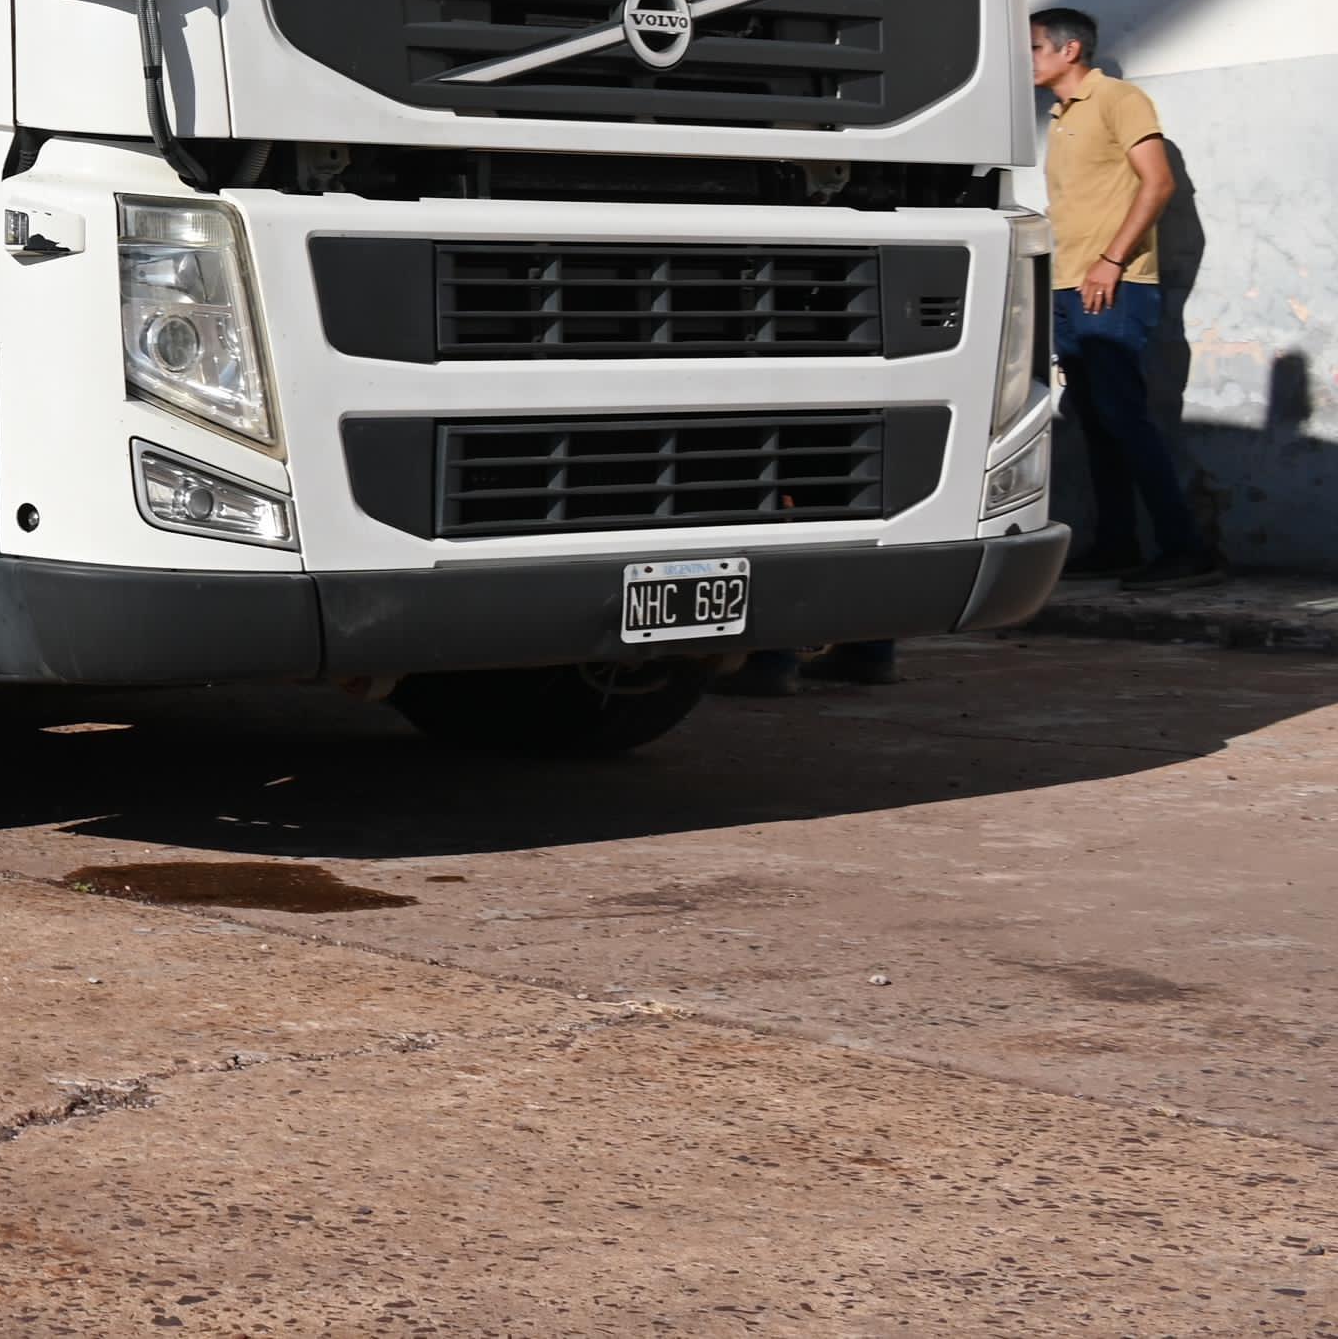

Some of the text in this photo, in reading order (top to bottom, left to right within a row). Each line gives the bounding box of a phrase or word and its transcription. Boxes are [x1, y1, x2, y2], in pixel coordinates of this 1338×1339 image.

[629, 11, 690, 30] VOLVO
[629, 579, 744, 627] NHC 692
